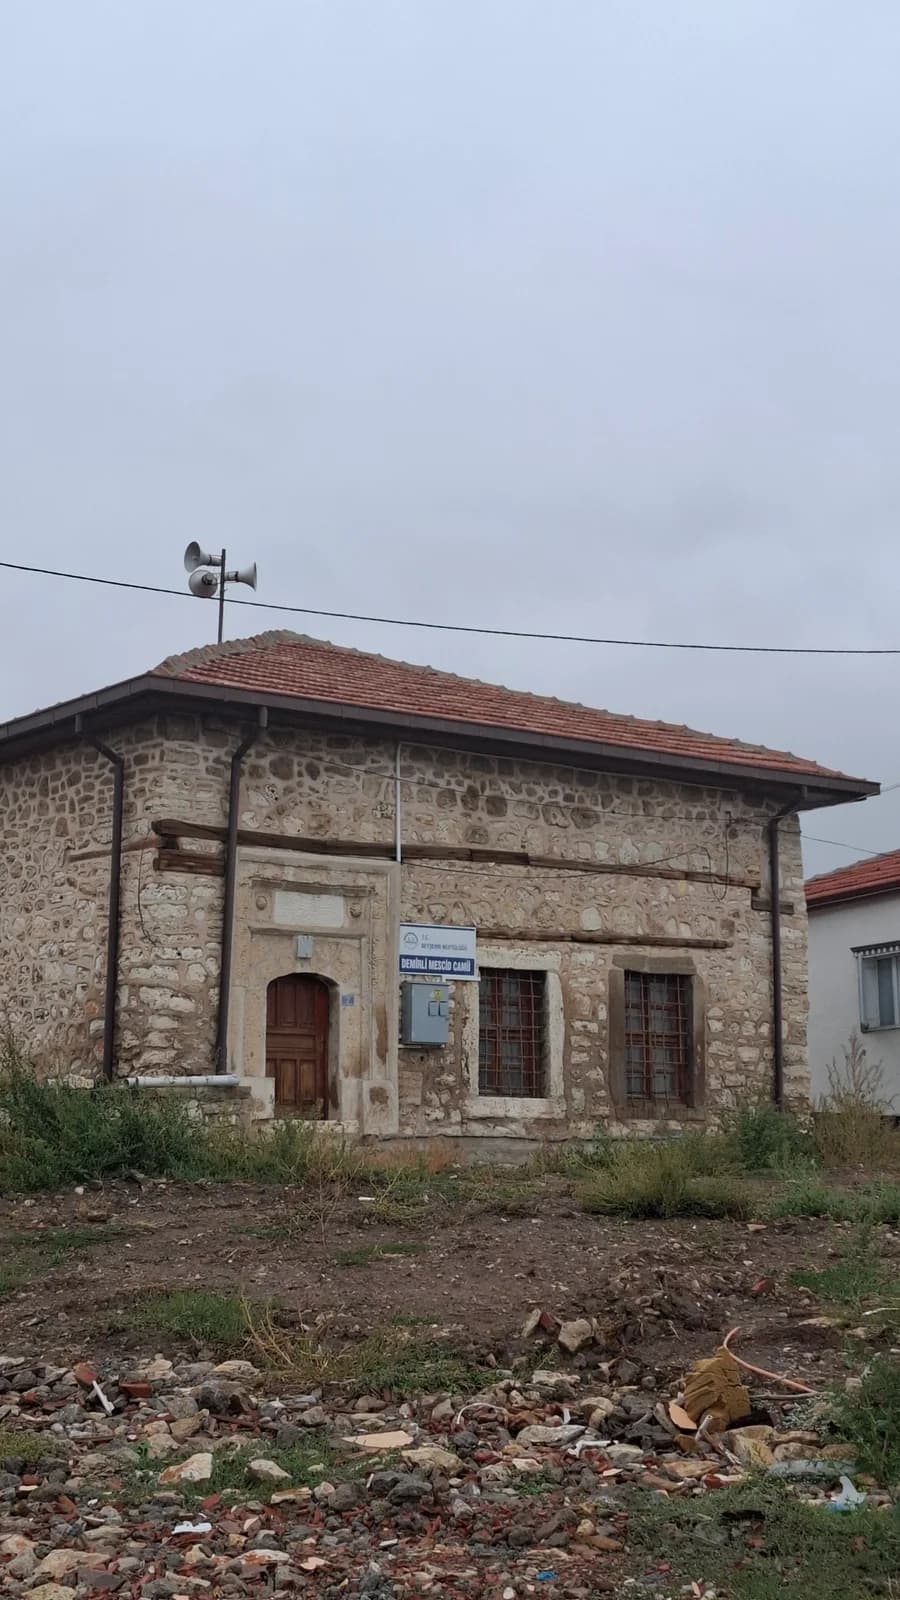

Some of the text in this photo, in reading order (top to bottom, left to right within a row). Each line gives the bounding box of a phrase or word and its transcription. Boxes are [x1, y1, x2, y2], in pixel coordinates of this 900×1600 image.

[401, 957, 471, 972] DEMİRLİ MESCİD CAMİİ
